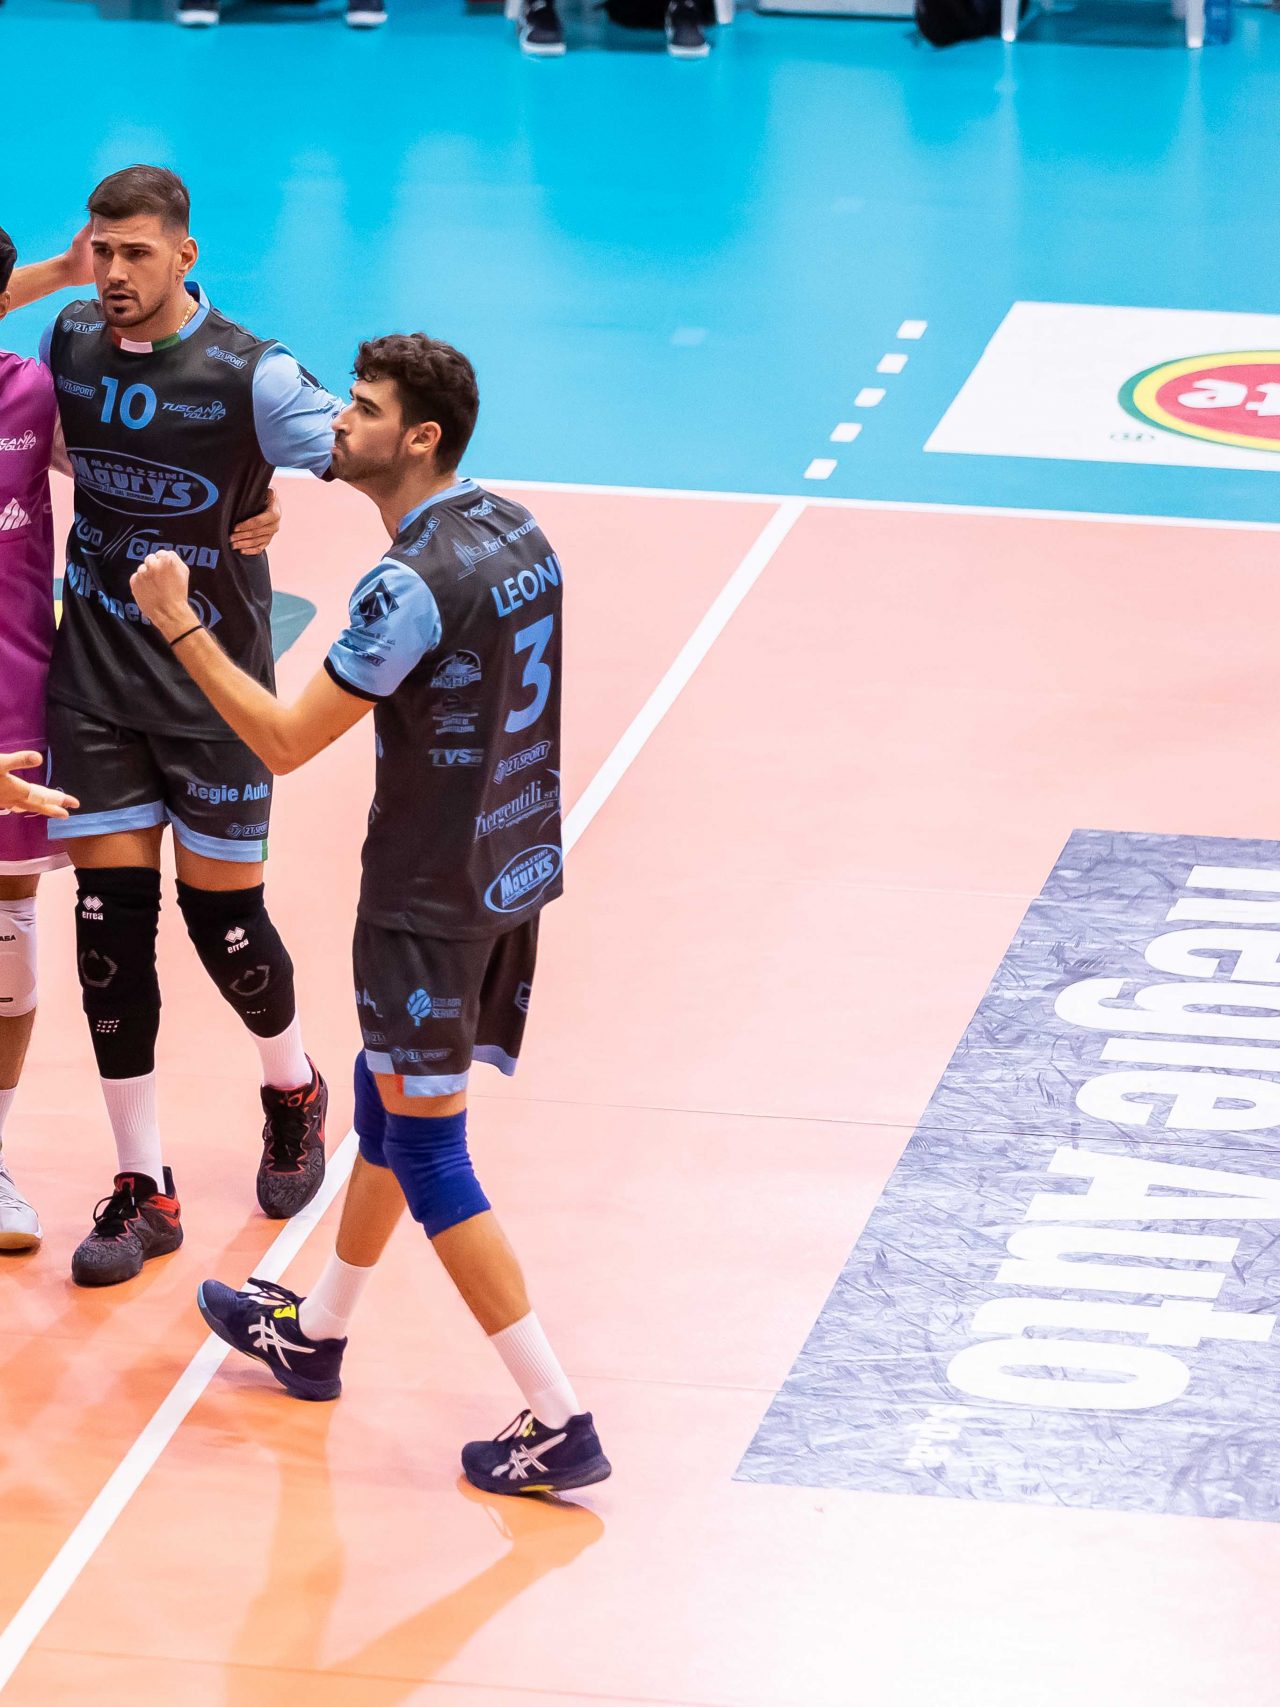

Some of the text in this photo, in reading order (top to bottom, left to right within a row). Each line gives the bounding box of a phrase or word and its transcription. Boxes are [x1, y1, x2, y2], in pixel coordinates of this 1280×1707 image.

[71, 384, 94, 398] SPORT
[100, 375, 157, 430] 10
[91, 459, 184, 481] MAGAZZINI
[504, 614, 554, 733] 3
[518, 744, 548, 766] SPORT
[187, 781, 239, 805] Regie
[946, 1146, 1280, 1411] Auto
